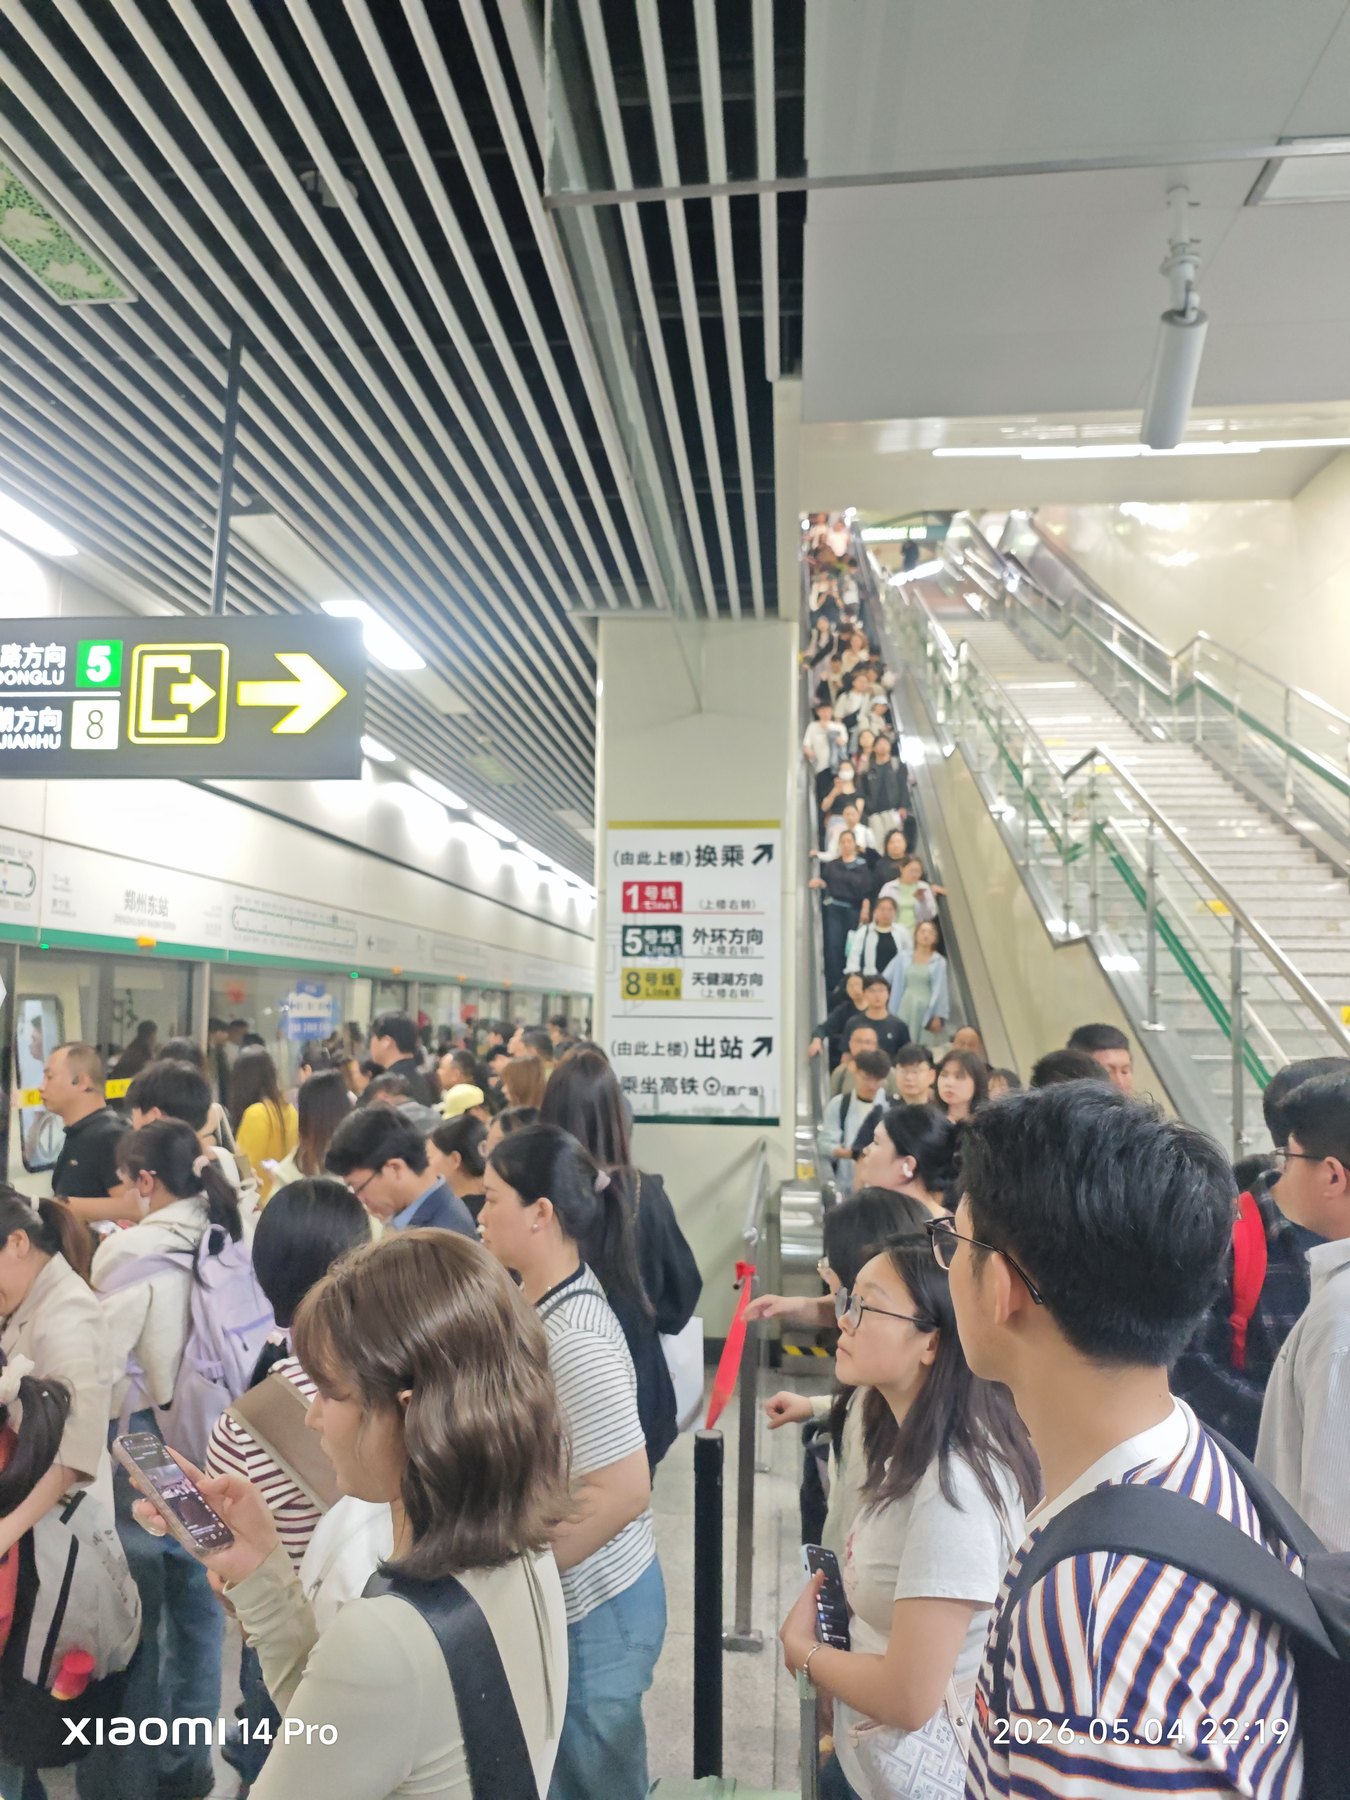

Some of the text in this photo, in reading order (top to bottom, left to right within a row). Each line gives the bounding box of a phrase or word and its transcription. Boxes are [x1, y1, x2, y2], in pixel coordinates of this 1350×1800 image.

[86, 645, 112, 683] 5
[86, 709, 104, 740] 8
[695, 844, 744, 868] 换乘
[124, 889, 169, 918] 郑州东站
[692, 928, 763, 945] 外环方向
[692, 972, 763, 986] 天健湖方向
[694, 1035, 743, 1059] 出站
